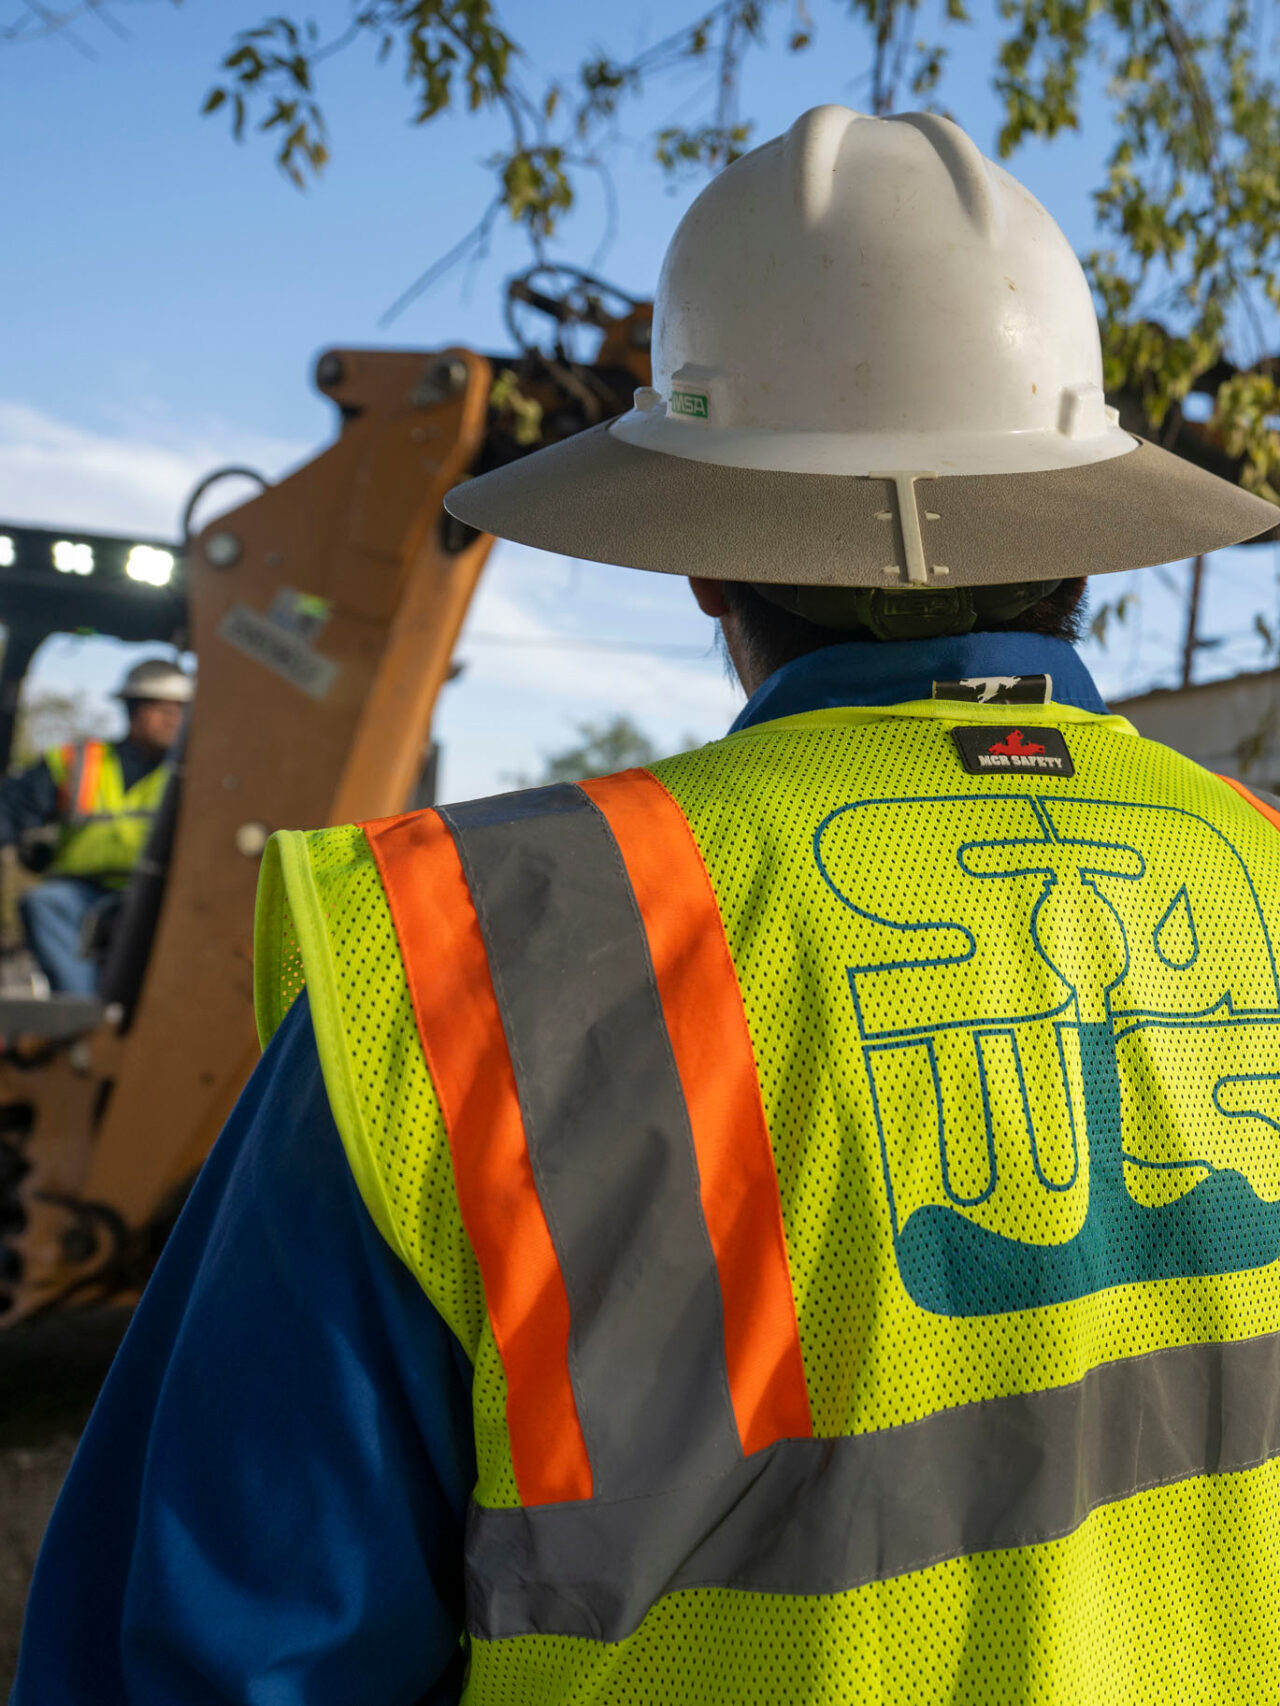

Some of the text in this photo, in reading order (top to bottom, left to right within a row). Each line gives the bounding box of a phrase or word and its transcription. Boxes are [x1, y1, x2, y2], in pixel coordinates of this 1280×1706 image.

[672, 393, 706, 416] MSA
[978, 755, 1063, 769] MCR SAFETY
